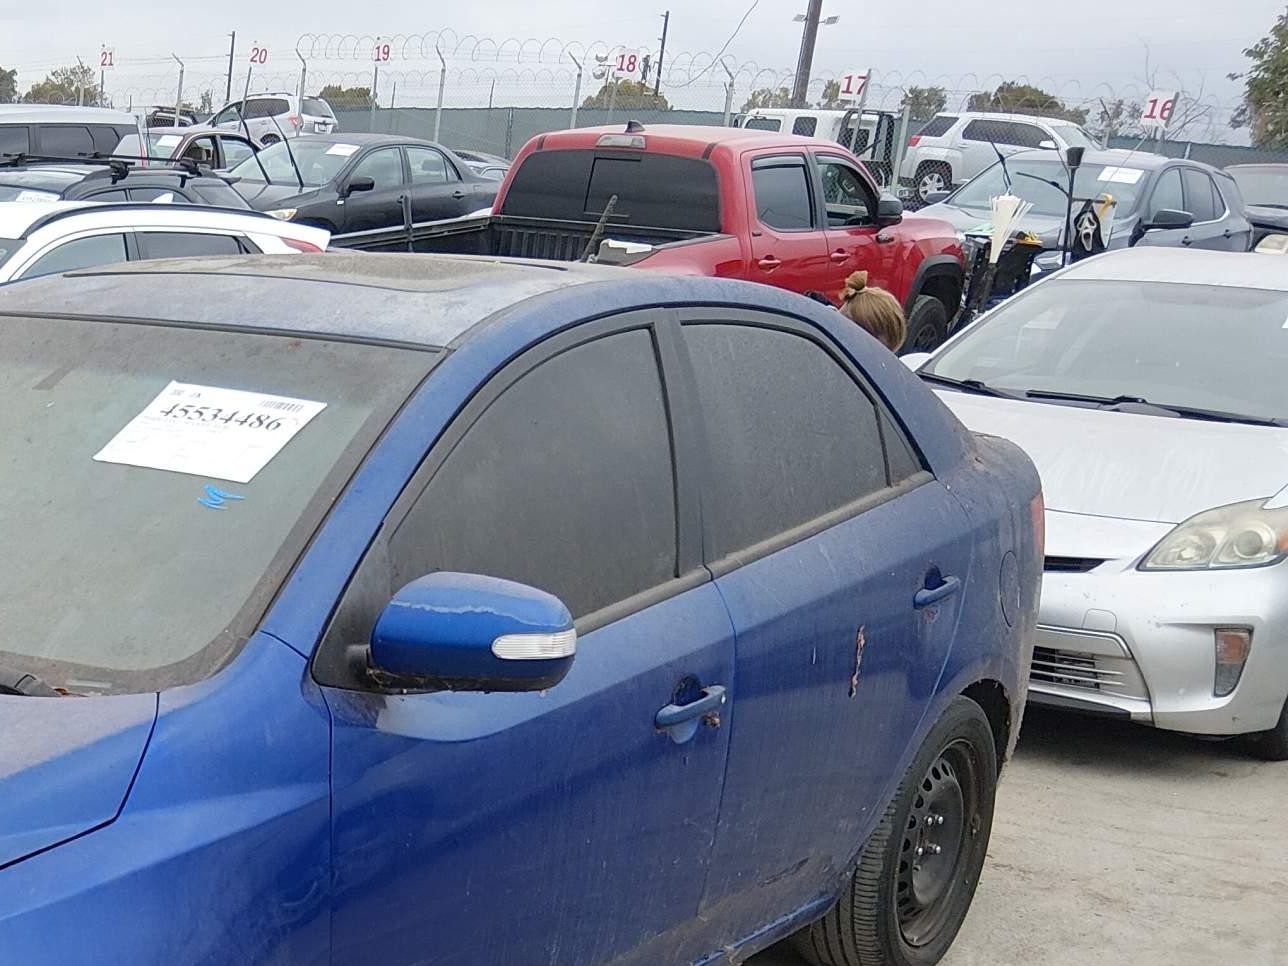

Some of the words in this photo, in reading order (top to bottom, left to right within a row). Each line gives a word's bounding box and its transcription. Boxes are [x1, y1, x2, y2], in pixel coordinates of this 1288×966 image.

[100, 51, 114, 67] 21
[250, 47, 267, 64] 20
[374, 44, 390, 62] 19
[616, 54, 637, 73] 18
[841, 75, 868, 95] 17
[1143, 98, 1173, 121] 16
[160, 402, 282, 431] 45534486
